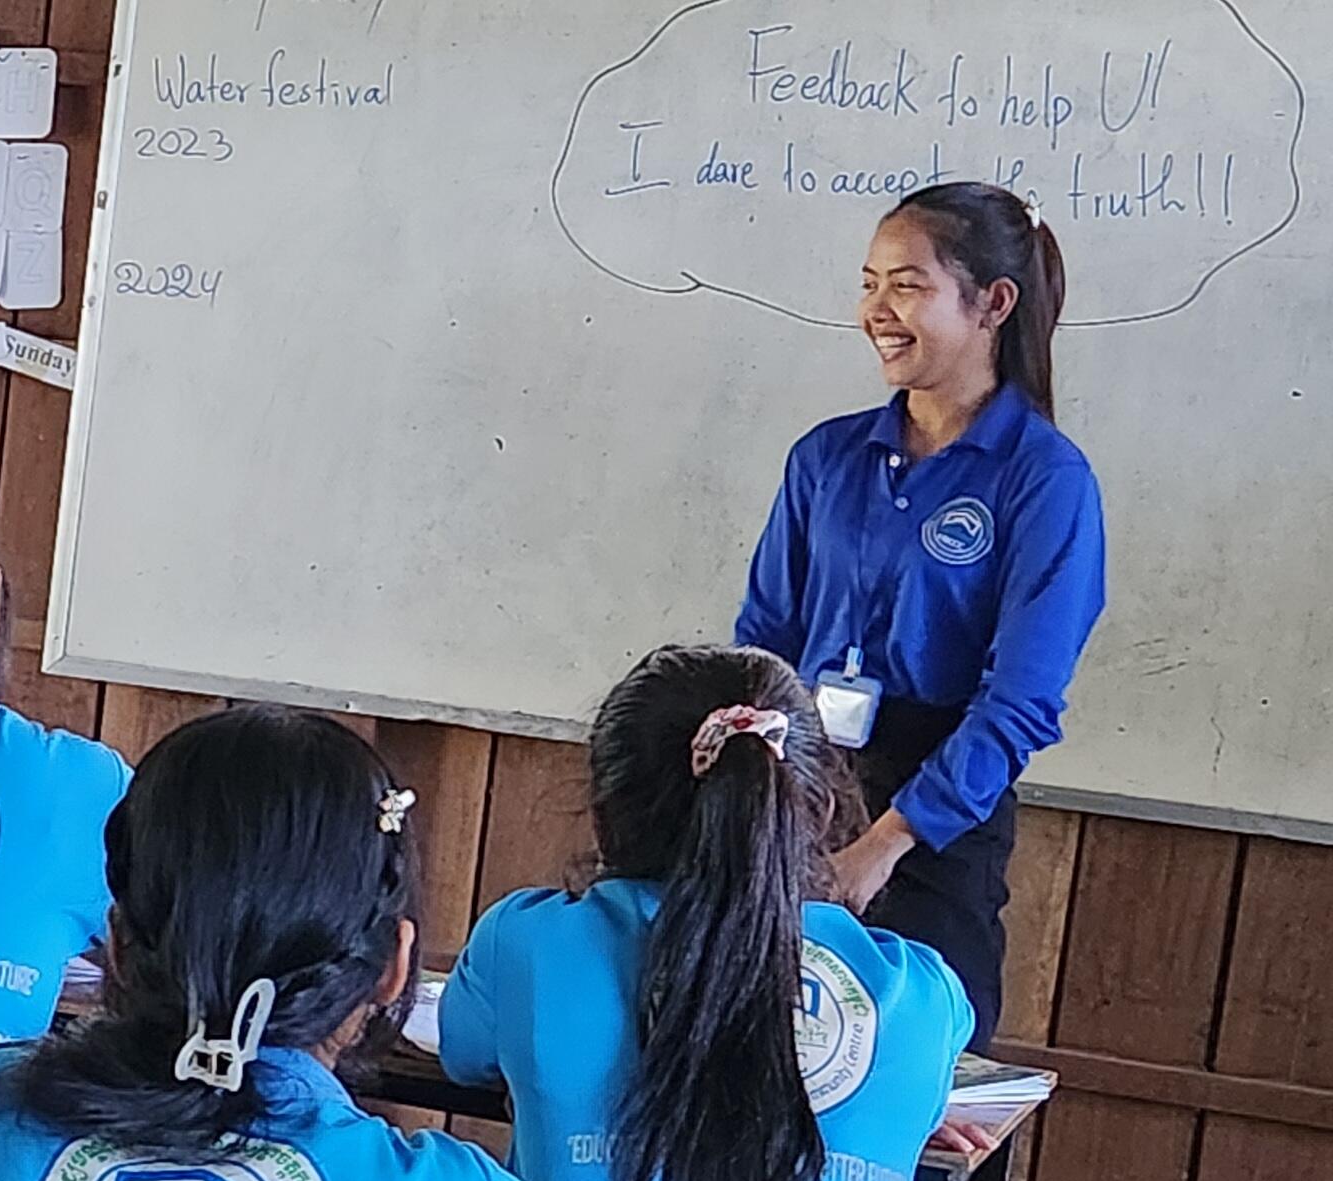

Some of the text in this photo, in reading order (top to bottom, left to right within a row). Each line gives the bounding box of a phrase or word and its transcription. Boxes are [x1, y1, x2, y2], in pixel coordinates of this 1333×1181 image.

[154, 49, 394, 111] Water festival
[747, 25, 919, 117] Feedback
[936, 53, 978, 119] to
[998, 54, 1074, 150] help
[134, 127, 234, 162] 2023
[605, 120, 671, 197] I
[695, 140, 758, 189] dare
[783, 142, 818, 194] to
[1070, 153, 1235, 226] truth!!
[113, 261, 223, 309] 2024
[5, 334, 76, 378] Sunday
